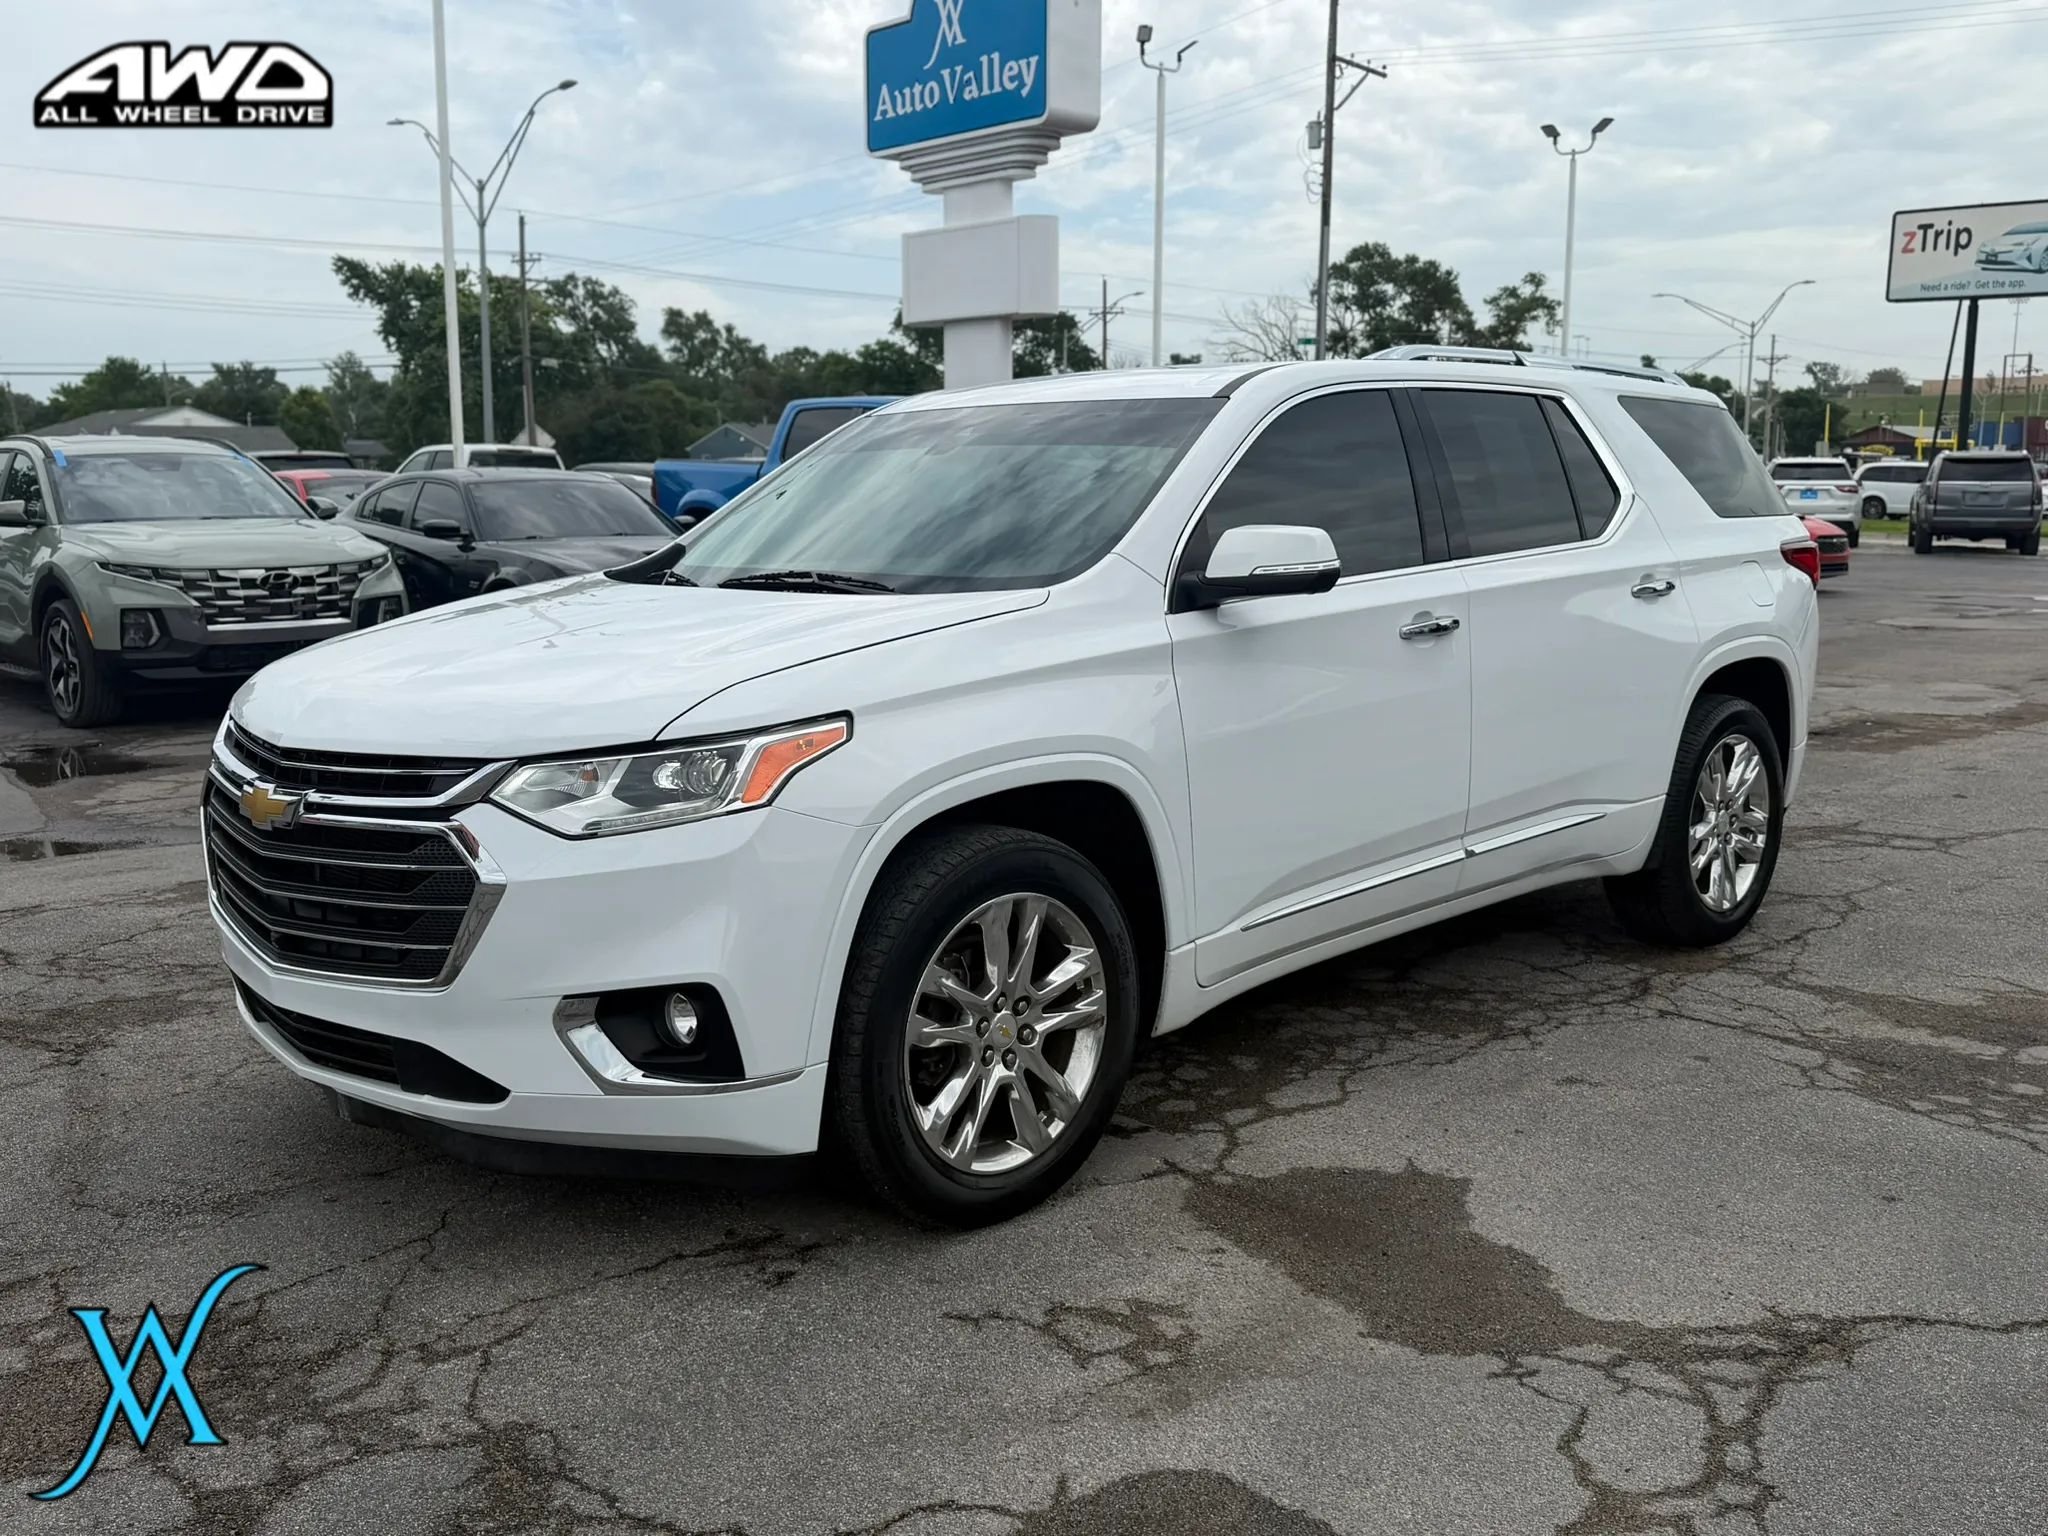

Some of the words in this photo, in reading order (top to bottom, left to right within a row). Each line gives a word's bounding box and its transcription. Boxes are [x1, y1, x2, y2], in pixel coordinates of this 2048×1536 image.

[1901, 220, 1974, 257] zTrip
[1920, 283, 1942, 293] Need
[1950, 281, 1971, 291] ride?
[1975, 280, 1991, 290] Get
[1992, 279, 2007, 289] the
